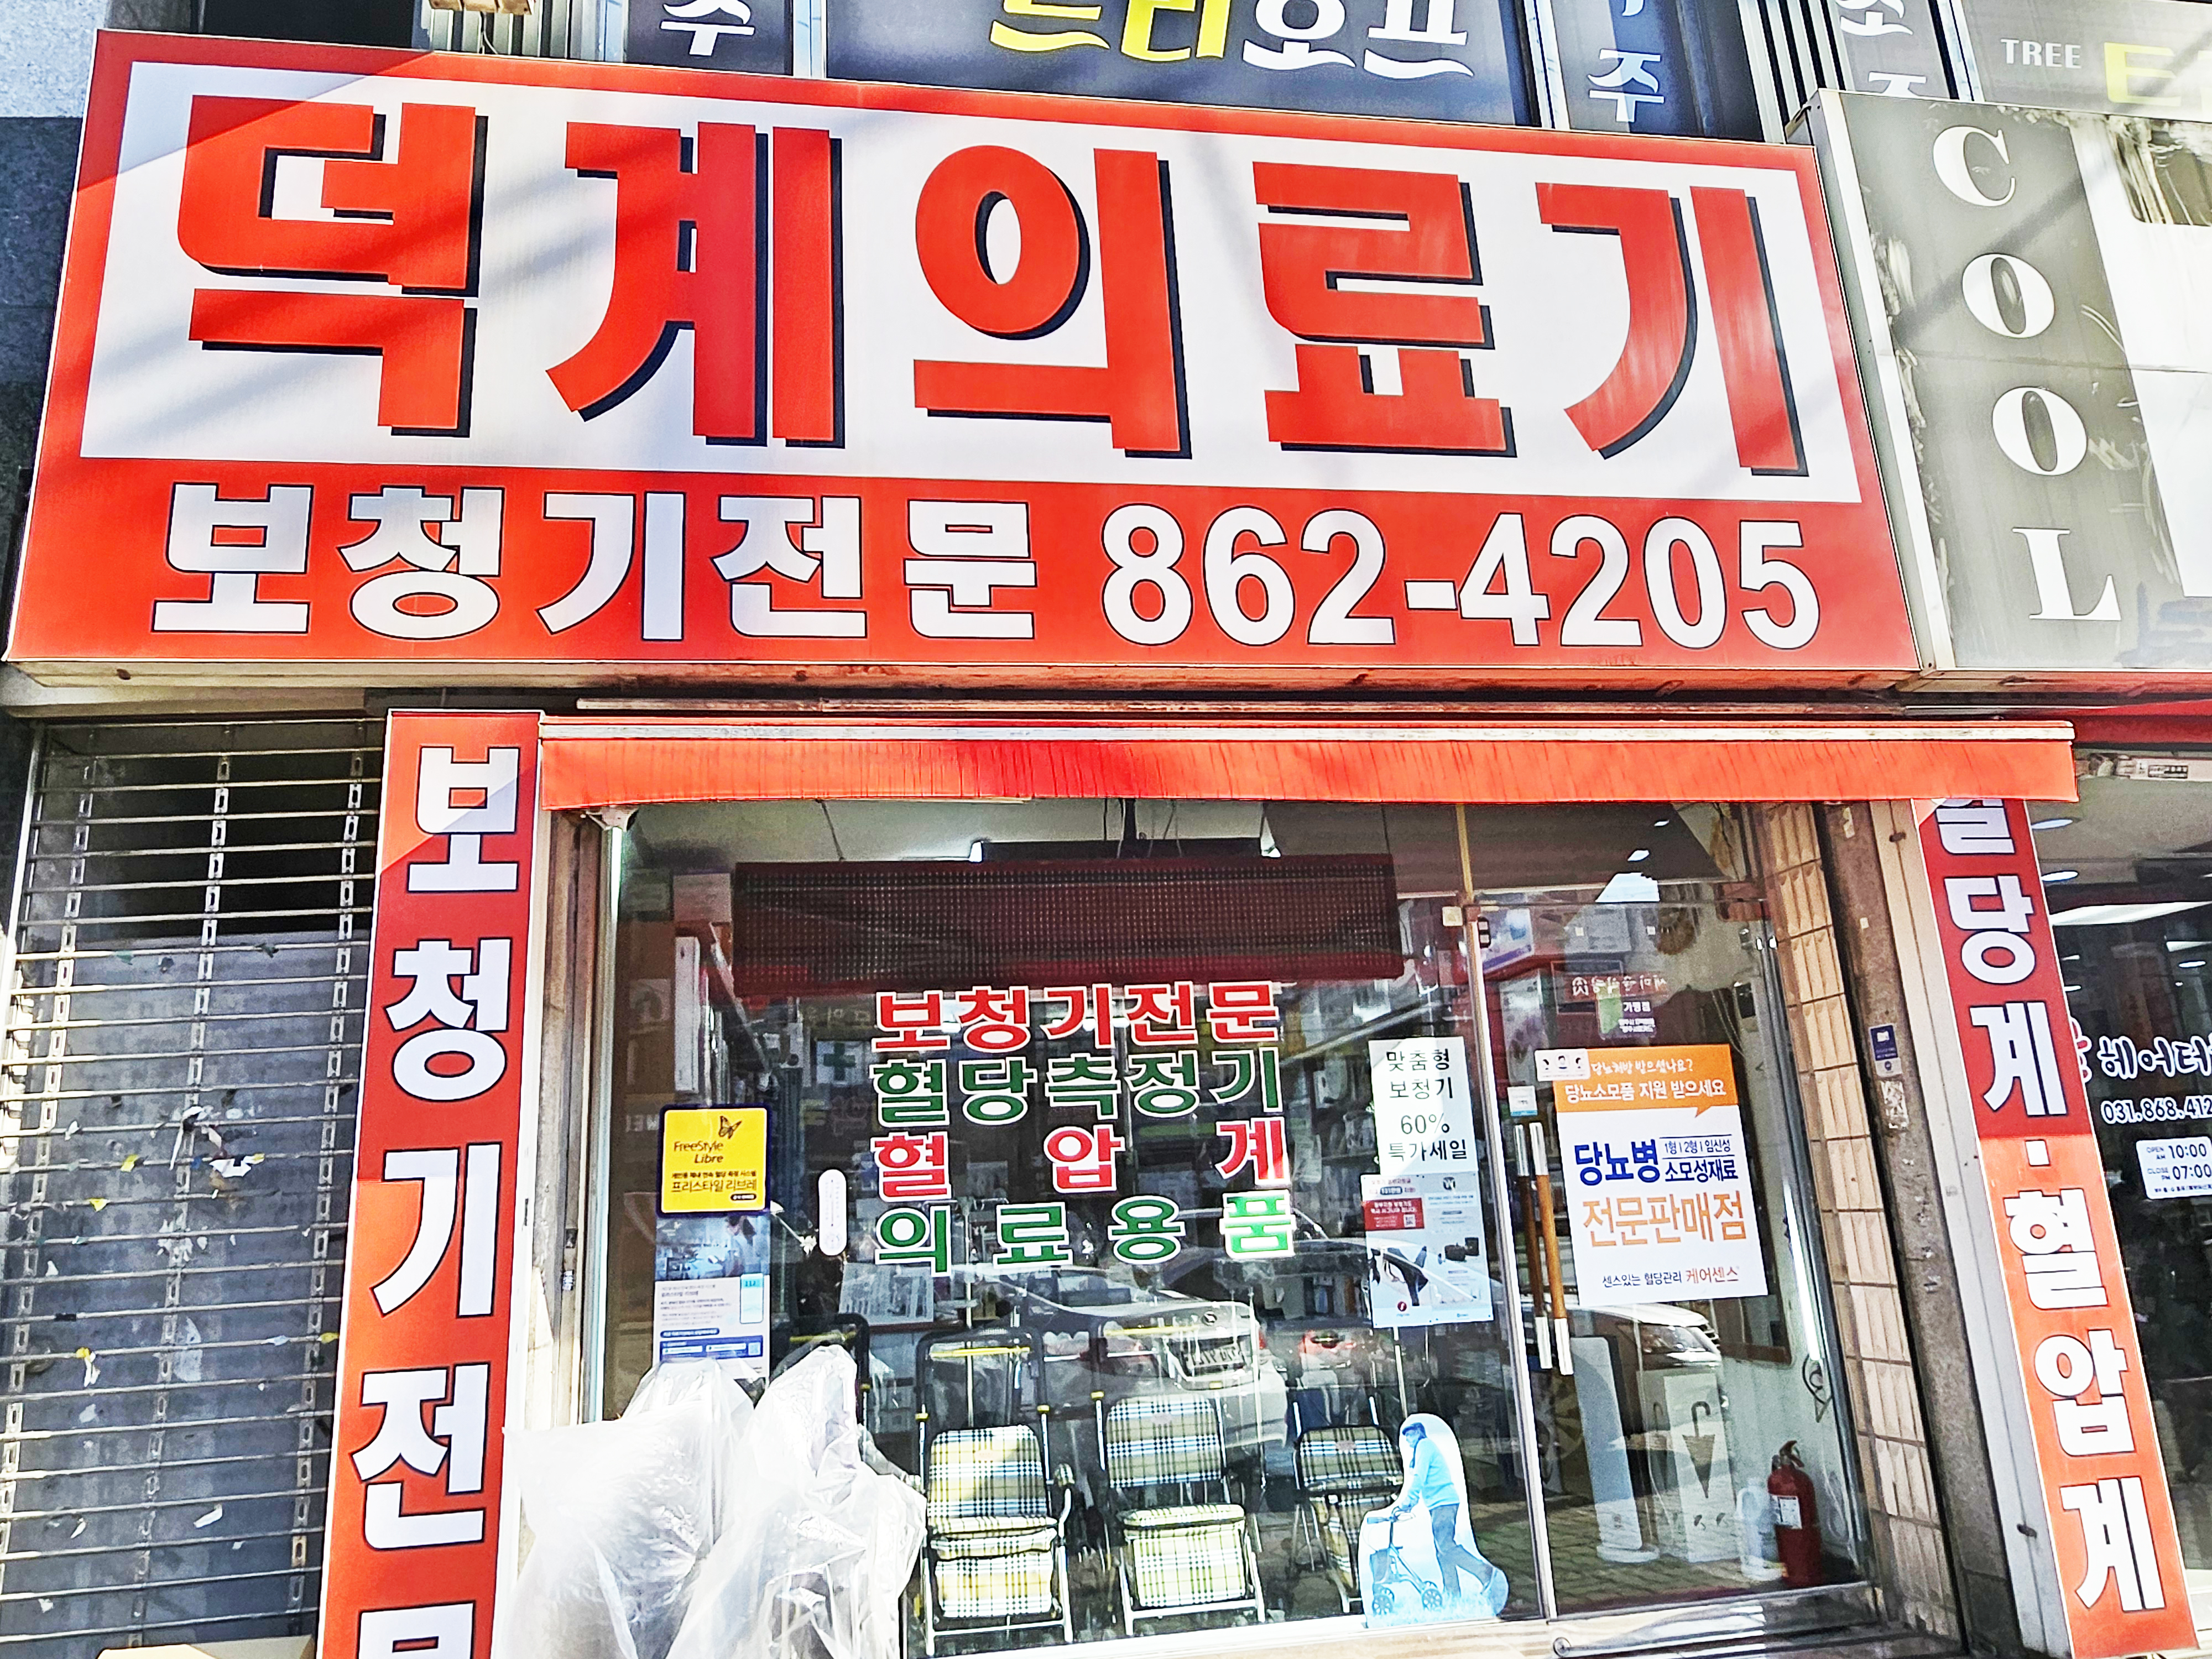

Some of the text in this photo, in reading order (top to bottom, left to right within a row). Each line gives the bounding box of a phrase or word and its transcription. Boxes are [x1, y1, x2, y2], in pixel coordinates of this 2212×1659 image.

[2000, 38, 2082, 69] TREE
[176, 94, 1808, 477] 덕계의료기
[1933, 125, 2122, 620] COOL
[151, 482, 1820, 650] 보청기전문 862-4205
[871, 980, 1282, 1053] 보청기전문
[1386, 1048, 1449, 1072] 맞춤형
[1590, 1058, 1693, 1076] 당뇨처방 받으셨나요?
[2097, 1035, 2212, 1079] 헤어터
[869, 1046, 1283, 1128] 혈당측정기
[1389, 1077, 1453, 1100] 보청기
[1564, 1079, 1726, 1103] 당뇨소모품 지원 받으세요
[1401, 1112, 1450, 1134] 60%
[674, 1140, 724, 1152] FreeStyle
[1388, 1139, 1467, 1161] 특가세일
[1705, 1139, 1731, 1152] 임신성
[2168, 1143, 2206, 1159] 10:00
[694, 1154, 724, 1164] Libre
[1574, 1138, 1661, 1186] 당뇨병
[1665, 1159, 1739, 1183] 소모성재료
[2172, 1164, 2212, 1180] 07:00
[671, 1178, 757, 1193] 프리스타일 리브레
[1582, 1190, 1747, 1247] 전문판매점
[1602, 1266, 1739, 1288] 센스있는 혈당관리 케어센스
